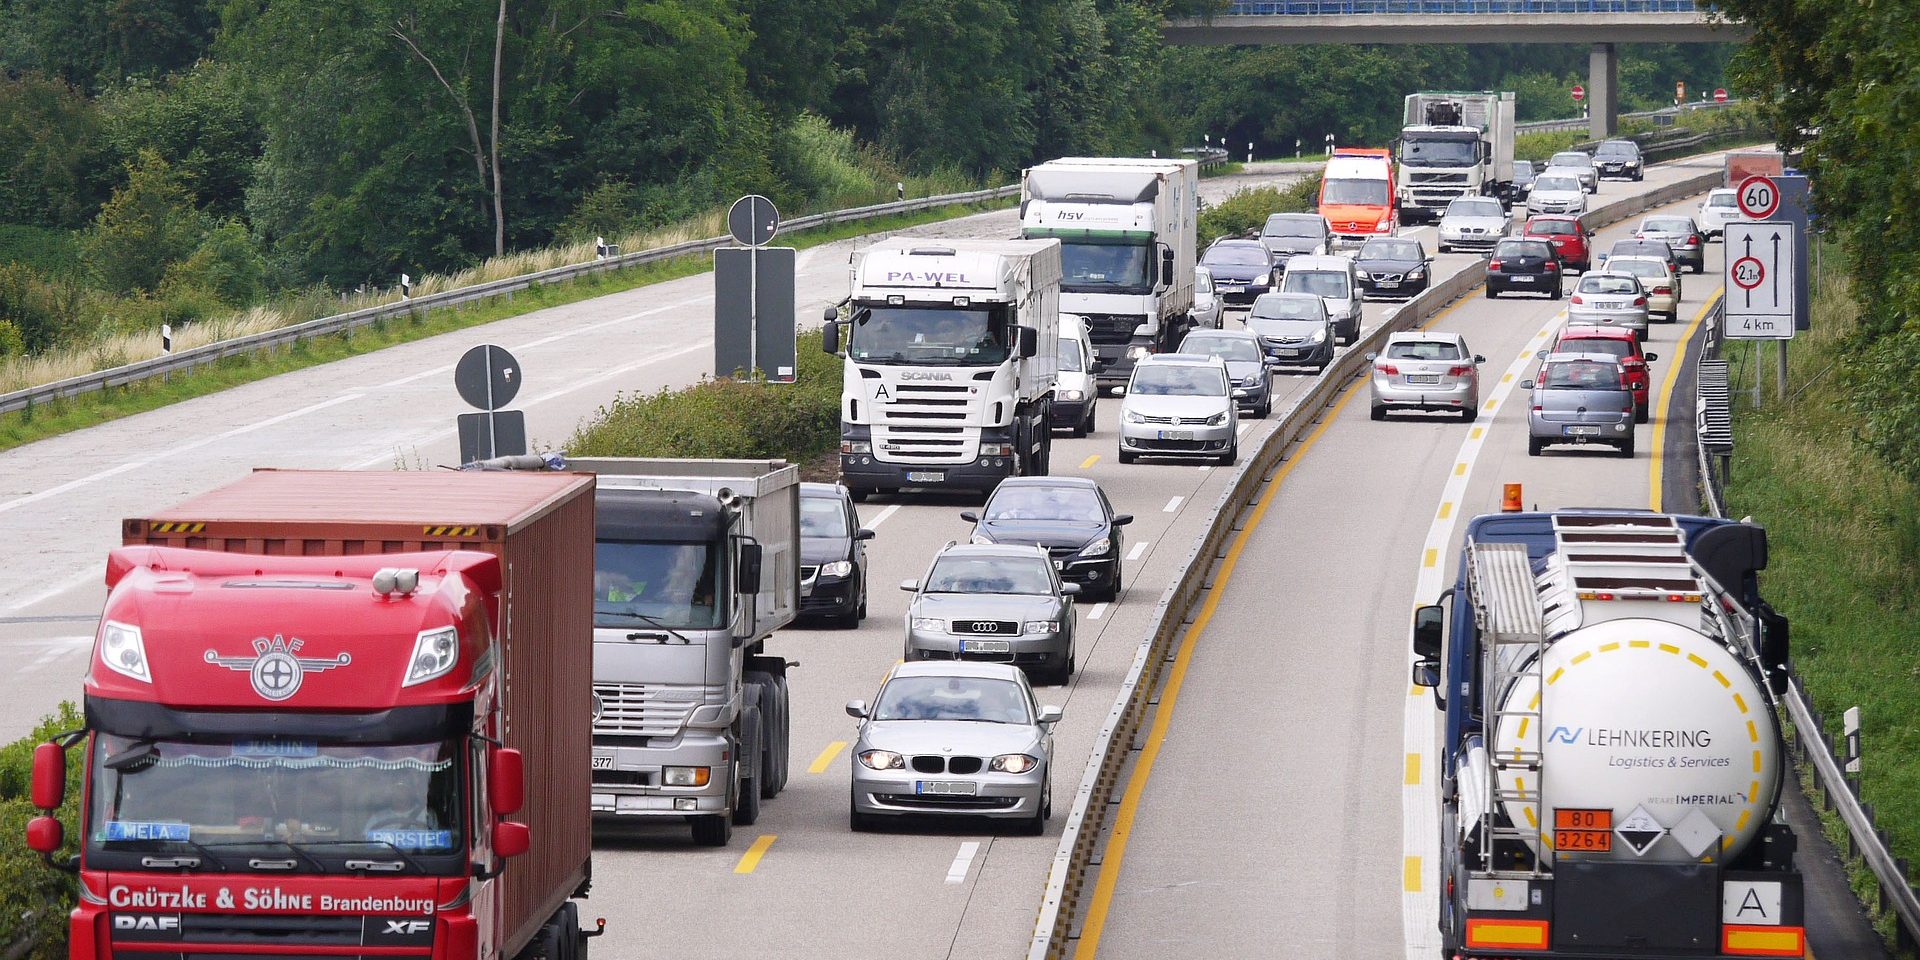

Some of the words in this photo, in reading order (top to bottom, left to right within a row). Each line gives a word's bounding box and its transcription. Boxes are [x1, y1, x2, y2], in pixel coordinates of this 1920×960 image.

[1746, 188, 1770, 207] 60
[1057, 210, 1084, 220] hsv
[887, 272, 971, 283] PA-WEL
[1743, 318, 1751, 331] 4
[1754, 318, 1774, 331] km
[901, 372, 953, 381] SCANIA
[874, 383, 890, 400] A
[252, 634, 305, 656] DAF
[1588, 728, 1711, 748] LEHNKERING
[593, 757, 612, 769] 377
[1608, 755, 1665, 769] Logistics
[1667, 756, 1678, 768] &
[1680, 756, 1730, 768] Services
[1676, 795, 1734, 804] IMPERIAL
[1572, 812, 1594, 827] 80
[123, 824, 170, 840] MELA
[1558, 832, 1607, 848] 3264
[216, 887, 236, 909] &
[320, 895, 434, 915] Brandenburg
[1736, 888, 1767, 918] A
[115, 915, 179, 930] DAF
[381, 920, 431, 934] XF
